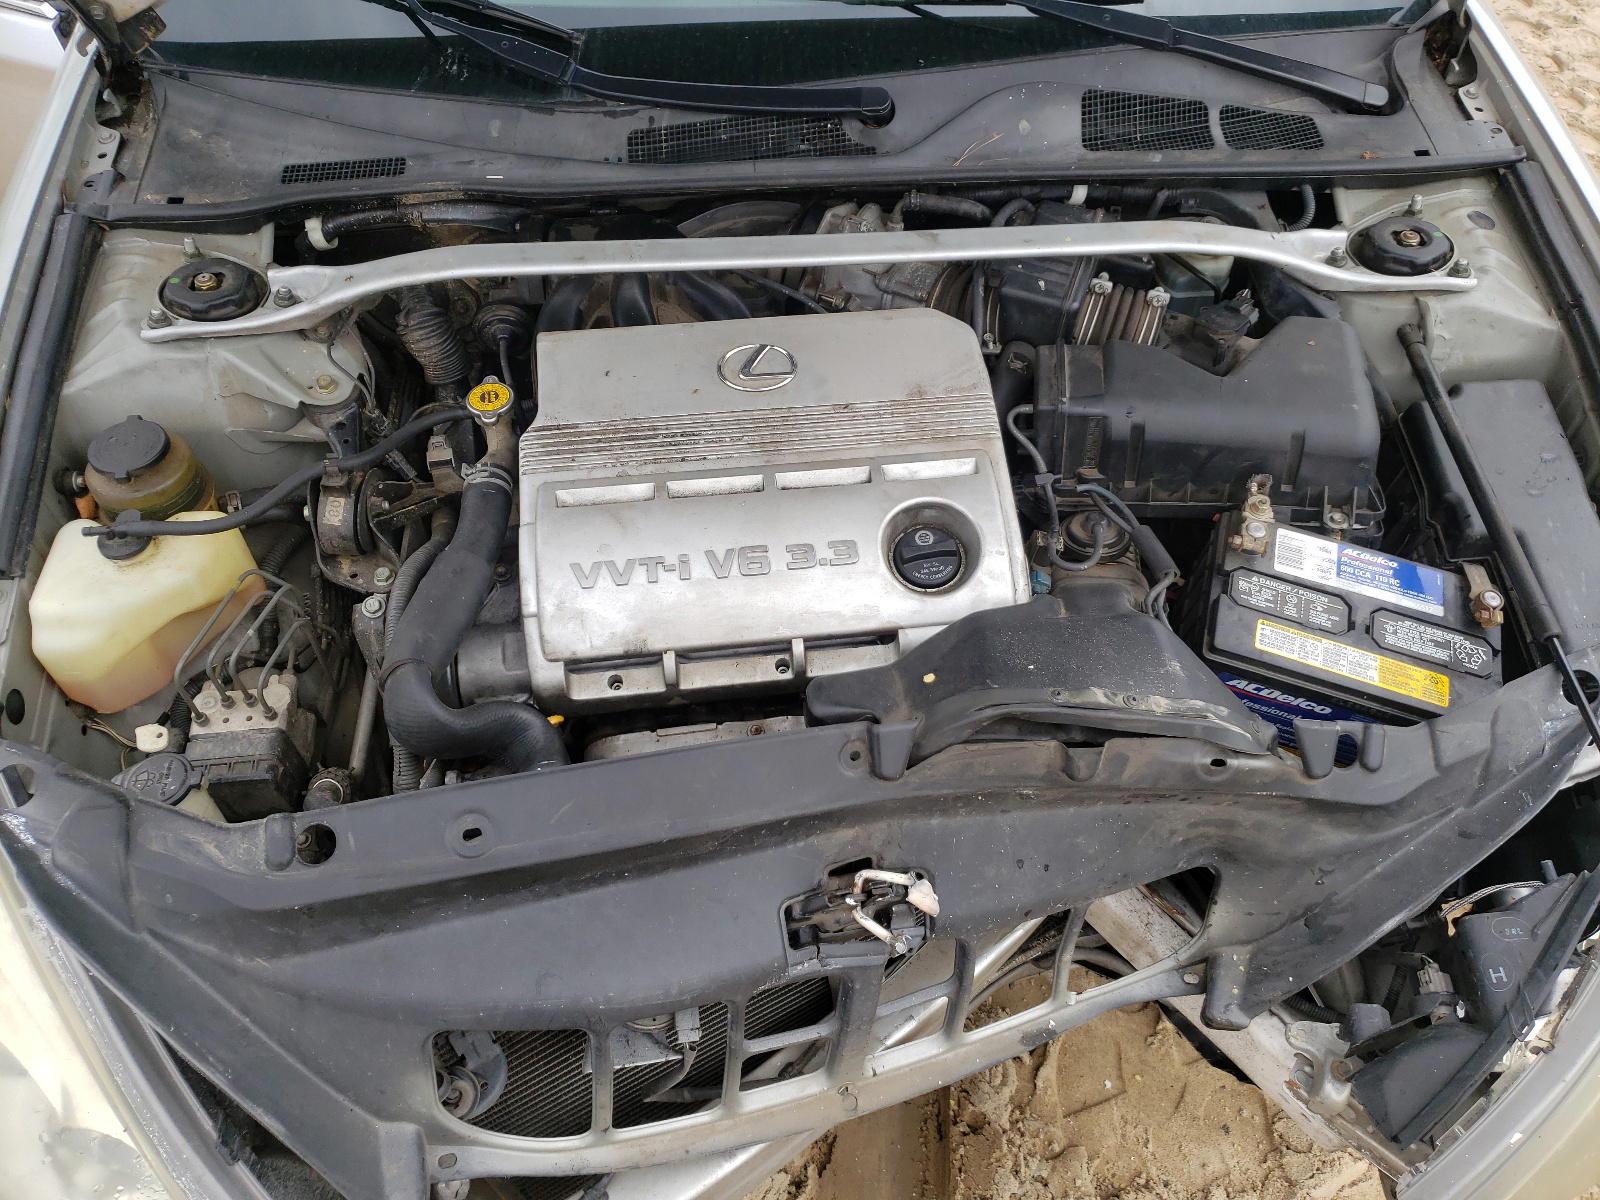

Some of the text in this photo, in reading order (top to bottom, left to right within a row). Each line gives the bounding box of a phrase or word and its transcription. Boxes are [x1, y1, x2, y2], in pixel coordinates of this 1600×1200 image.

[569, 540, 861, 590] VVT-i V6 3.3
[1341, 548, 1399, 569] ACDelco
[1341, 556, 1393, 577] Professional
[1355, 569, 1371, 579] CCA
[1389, 578, 1400, 587] RC
[1259, 578, 1292, 593] DANGER
[1298, 589, 1329, 603] POISON
[1226, 679, 1332, 714] ACDelco
[1489, 966, 1508, 984] H
